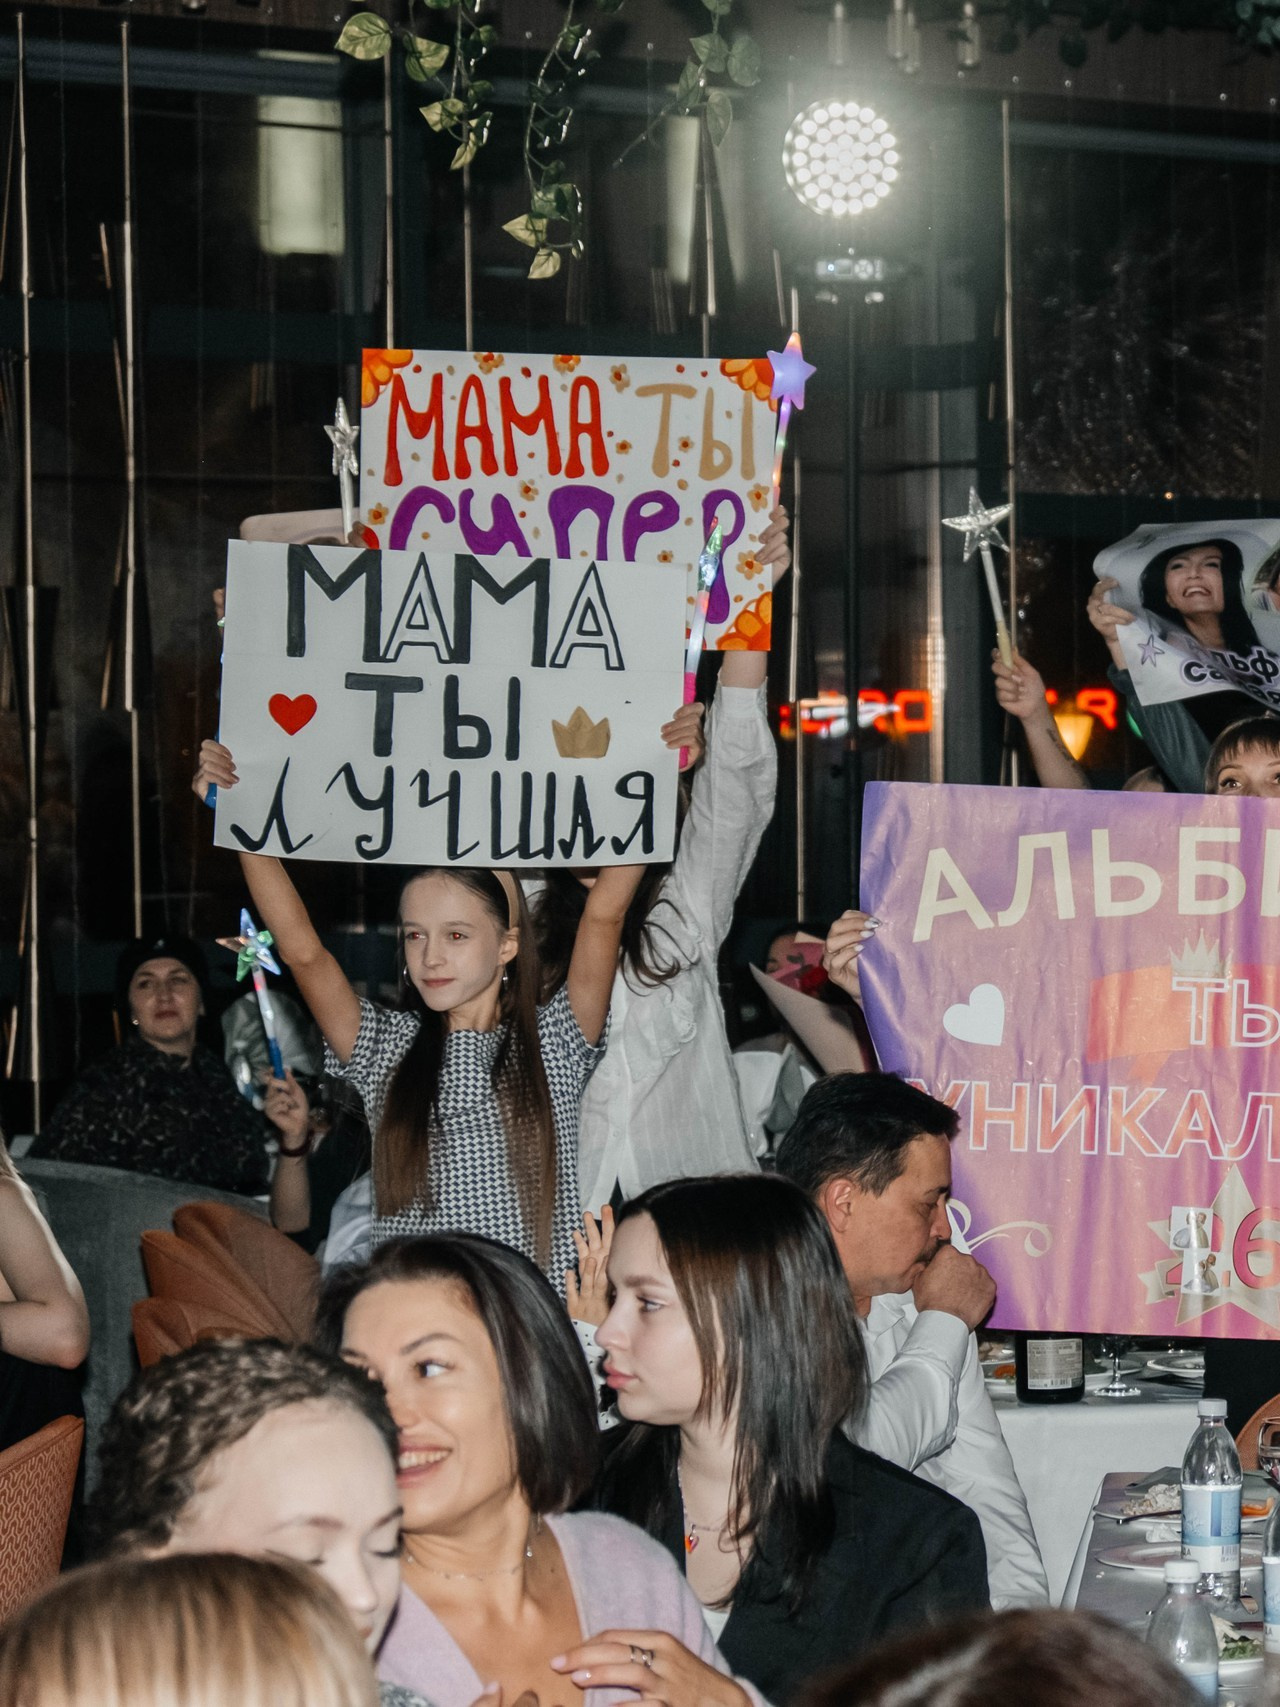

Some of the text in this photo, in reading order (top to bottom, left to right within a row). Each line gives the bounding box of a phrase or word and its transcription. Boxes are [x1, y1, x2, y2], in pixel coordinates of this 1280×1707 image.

[384, 372, 756, 486] МАМА ТЫ
[286, 544, 625, 670] МАМА
[345, 672, 521, 760] ТЫ
[230, 757, 655, 861] ЛУЧШАЯ
